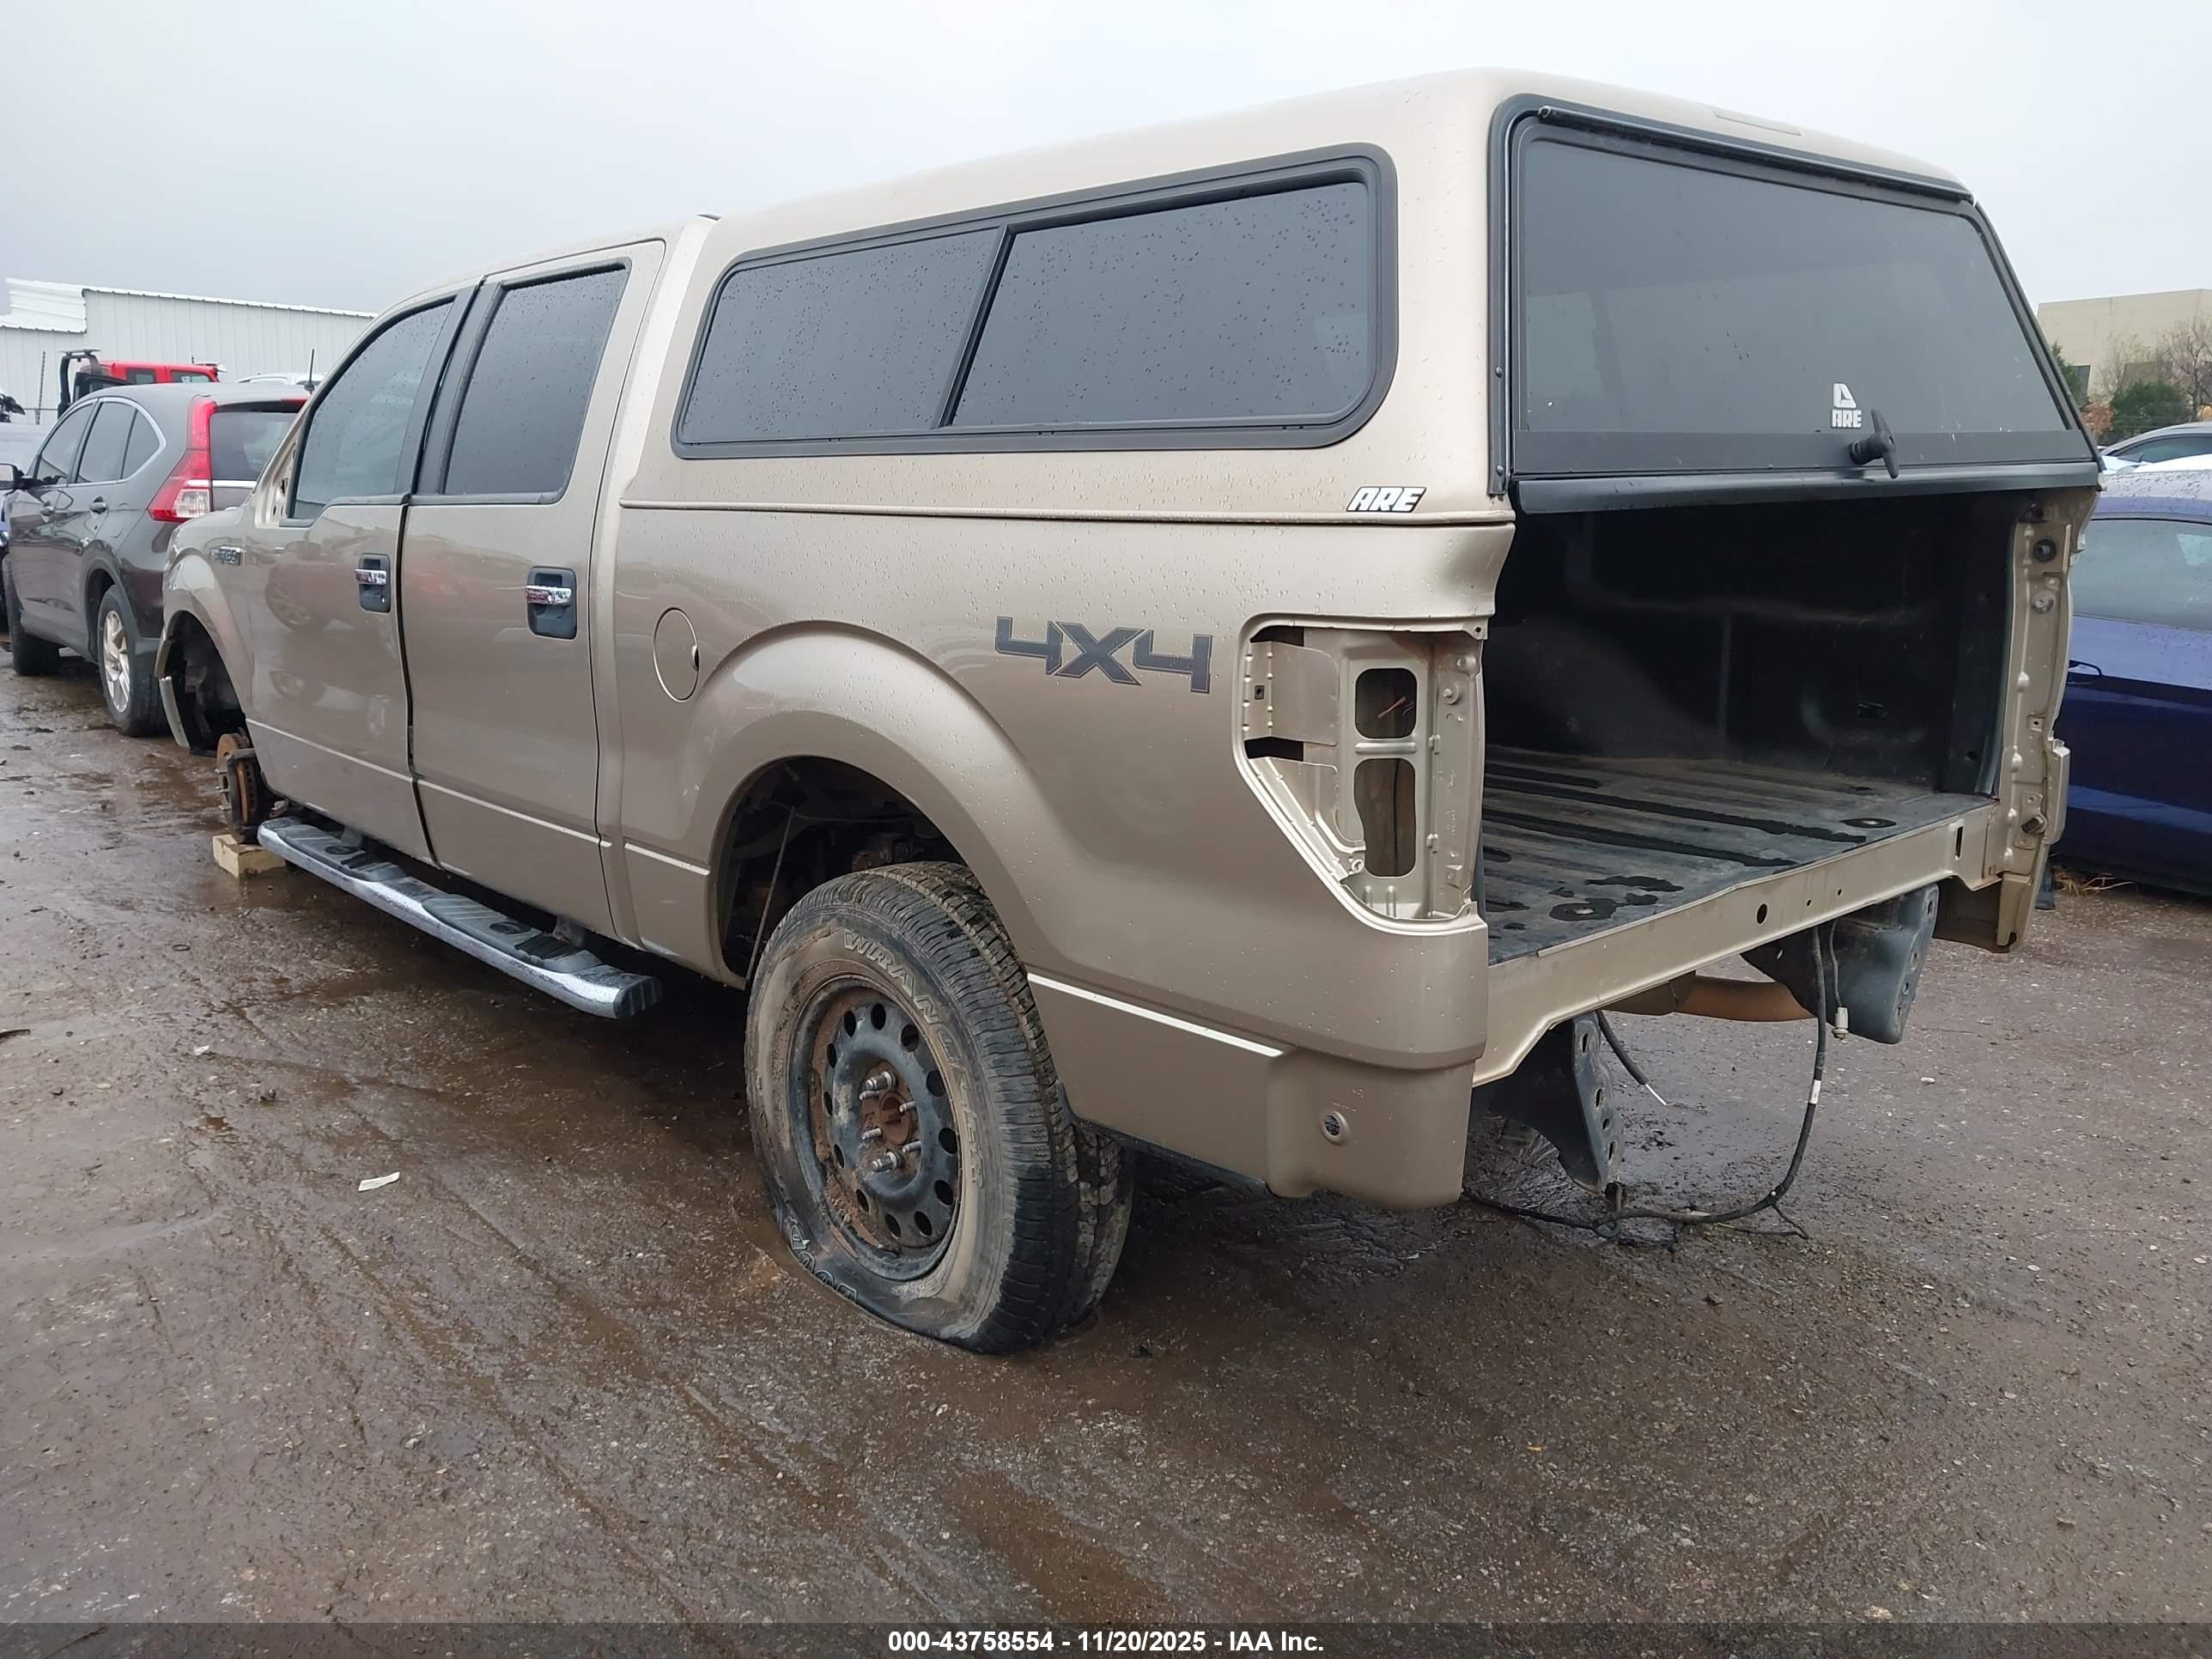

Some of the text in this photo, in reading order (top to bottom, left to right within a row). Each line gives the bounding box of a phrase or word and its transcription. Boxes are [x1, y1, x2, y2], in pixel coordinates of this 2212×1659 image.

[1831, 409, 1863, 428] ARE
[1346, 486, 1427, 513] ARE
[843, 928, 985, 1188] WRANGLER
